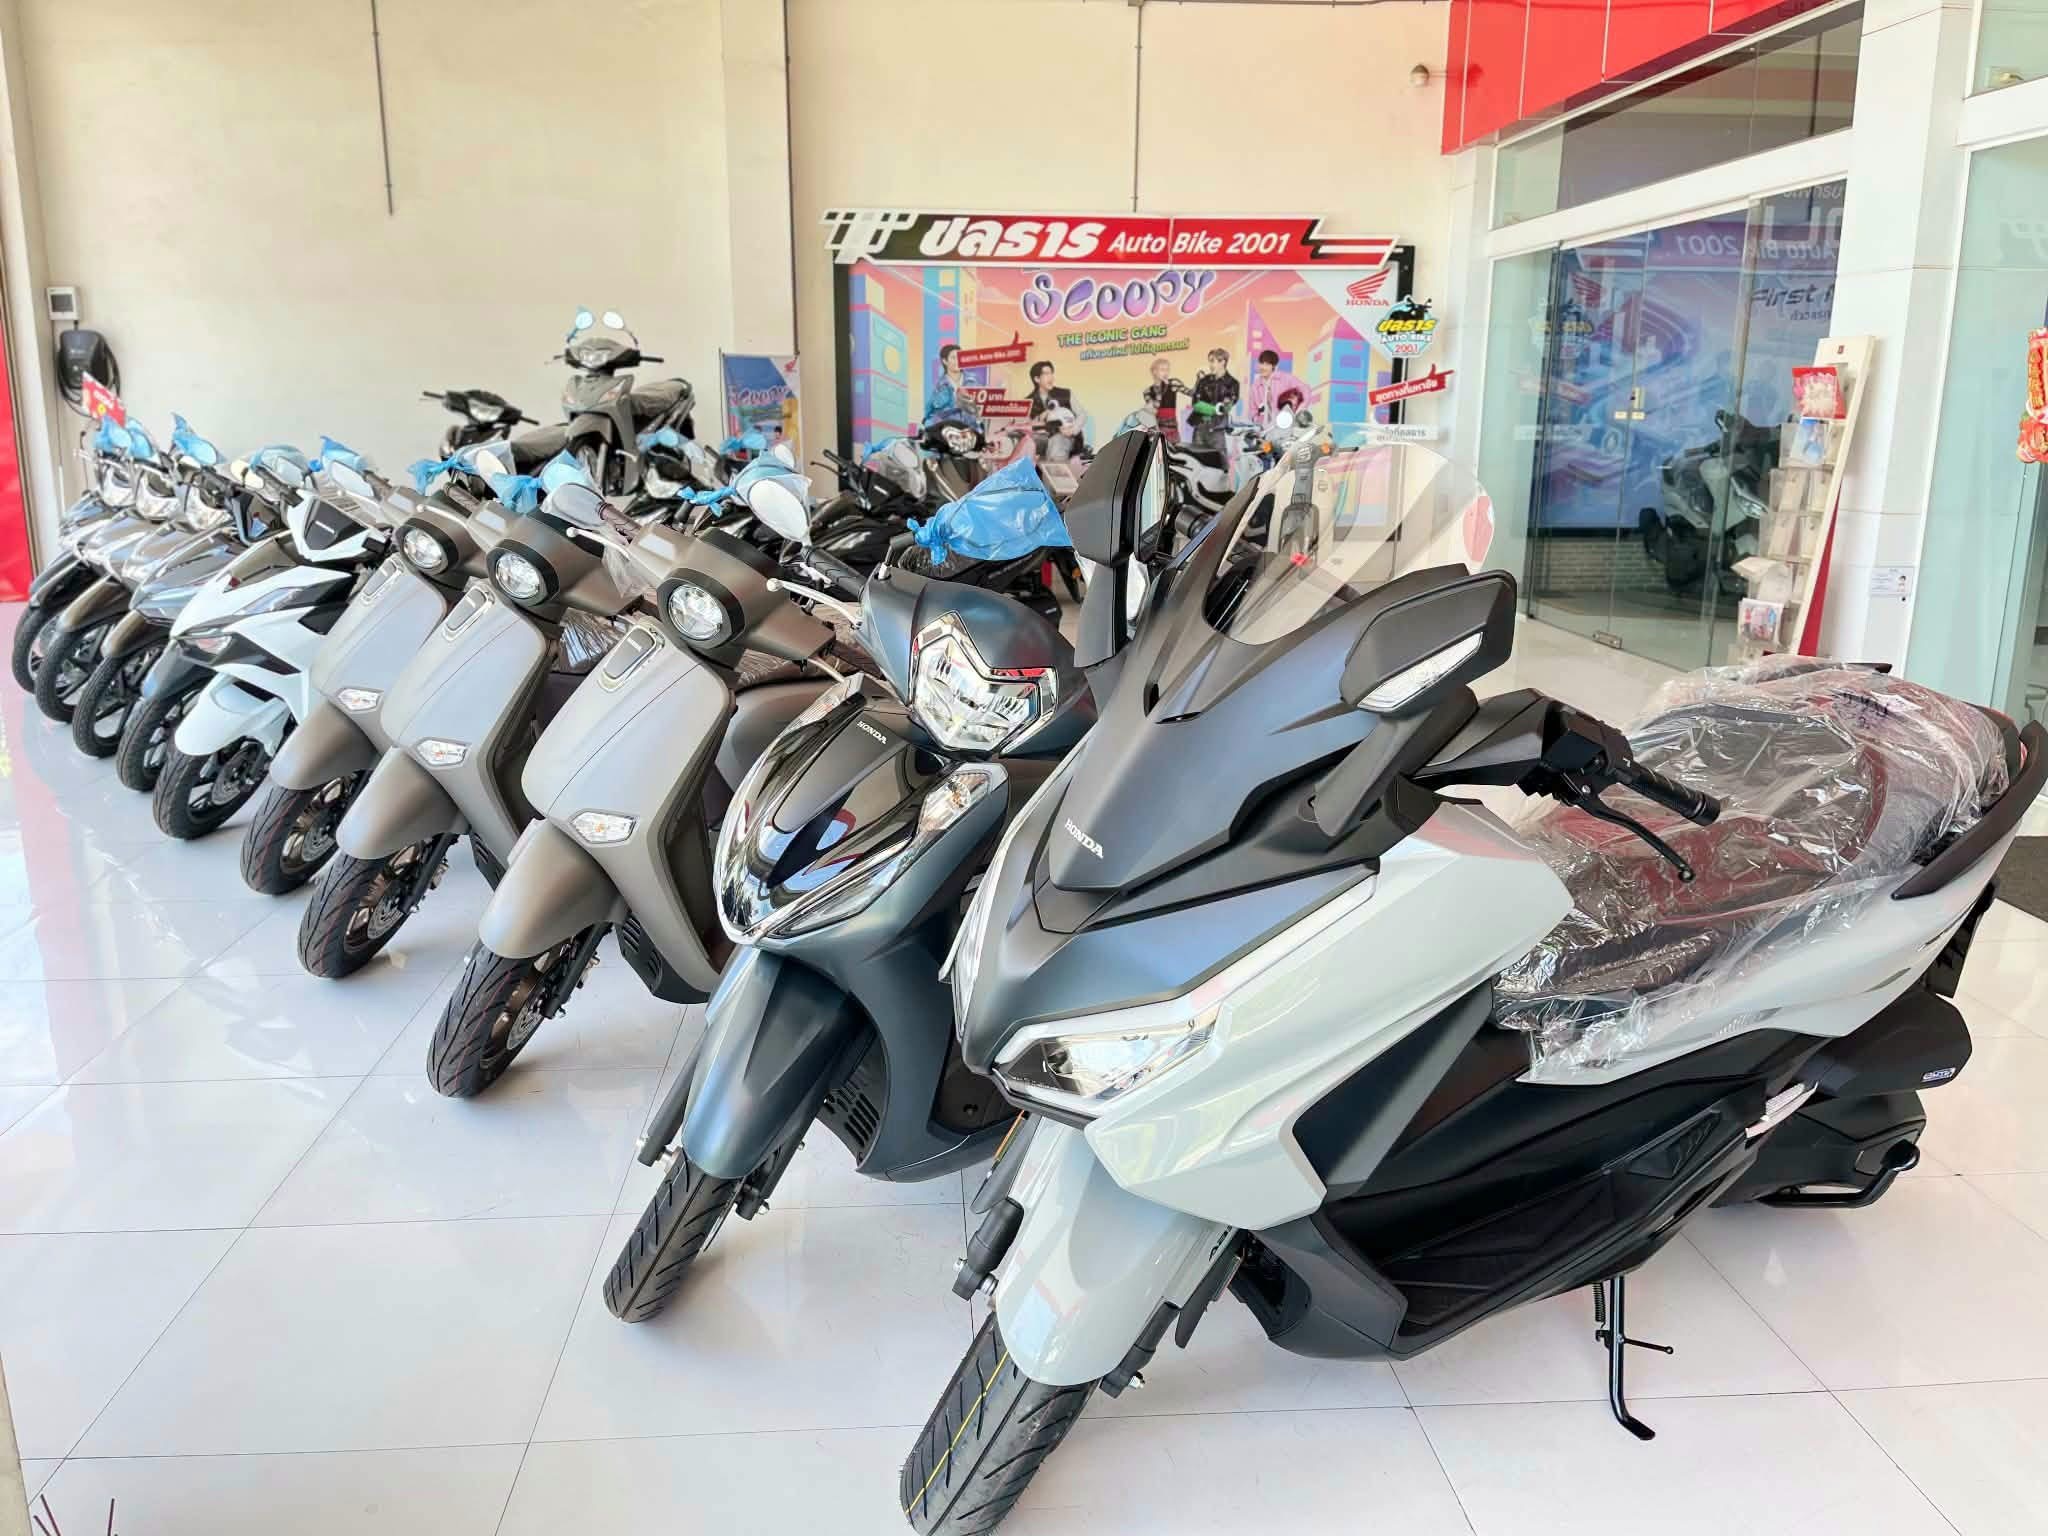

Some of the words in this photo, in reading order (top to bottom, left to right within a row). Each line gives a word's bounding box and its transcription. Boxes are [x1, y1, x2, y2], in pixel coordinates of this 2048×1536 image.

[1107, 231, 1167, 253] Auto
[1172, 230, 1223, 254] Bike
[1226, 232, 1292, 254] 2001
[1345, 299, 1389, 307] HONDA
[1057, 334, 1082, 347] THE
[1085, 329, 1128, 345] ICONIC
[1131, 325, 1168, 341] GANG
[1394, 343, 1418, 353] 2001
[857, 720, 887, 744] HONDA
[1065, 818, 1104, 859] HONDA
